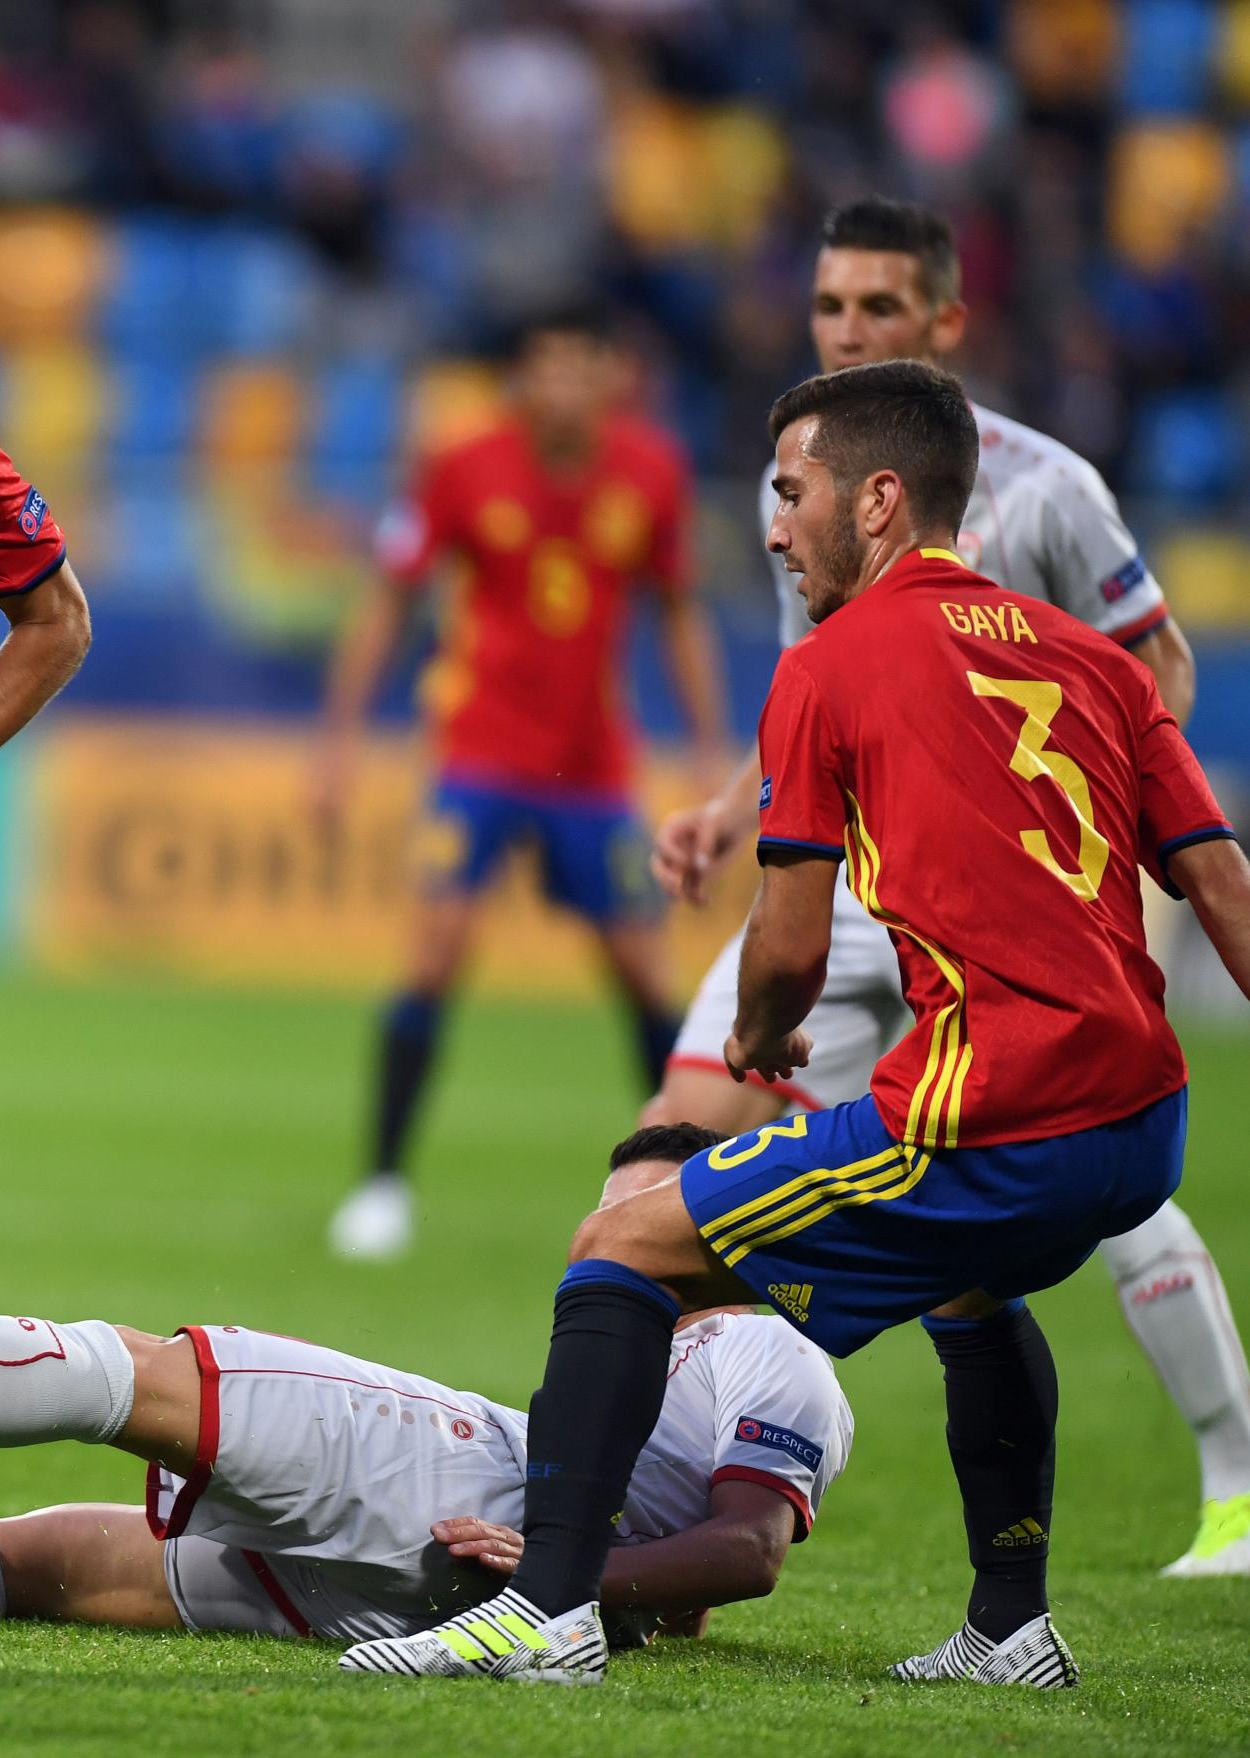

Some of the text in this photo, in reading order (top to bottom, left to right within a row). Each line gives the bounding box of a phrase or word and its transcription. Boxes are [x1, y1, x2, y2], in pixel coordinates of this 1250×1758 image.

[966, 671, 1109, 901] 3
[708, 1114, 807, 1170] 3
[768, 1284, 809, 1322] adidas
[762, 1430, 820, 1465] RESPECT
[993, 1533, 1048, 1546] adidas
